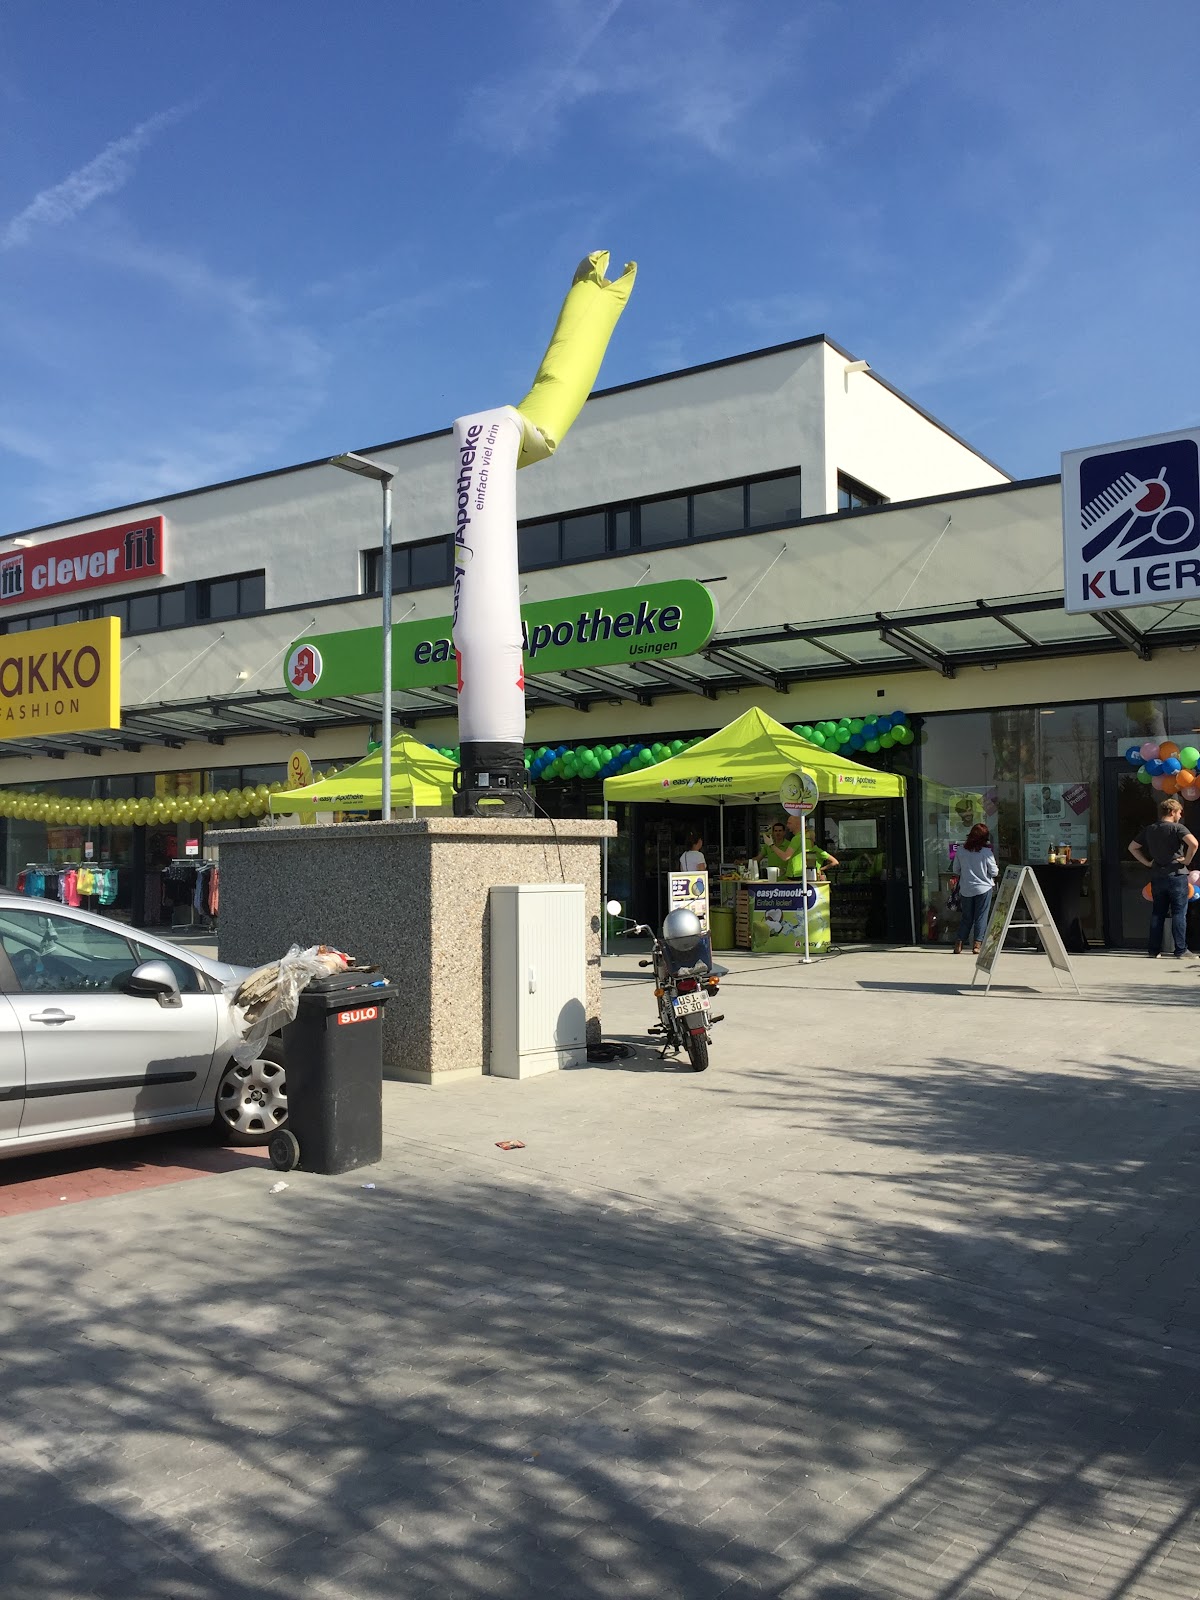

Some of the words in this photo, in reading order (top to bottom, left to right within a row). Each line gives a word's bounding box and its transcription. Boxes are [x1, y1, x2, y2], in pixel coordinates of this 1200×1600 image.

[485, 423, 500, 445] drin
[481, 446, 493, 467] viel
[455, 425, 484, 545] Apotheke
[474, 469, 489, 511] einfach
[31, 547, 120, 590] clever
[123, 526, 156, 571] fit
[2, 564, 22, 595] fit
[1082, 559, 1200, 600] KLIER
[414, 637, 457, 665] ea
[521, 600, 683, 658] potheke
[629, 640, 678, 655] Usingen
[0, 698, 79, 721] ASHION
[756, 888, 813, 899] easySmoothe
[341, 1007, 376, 1023] SULO
